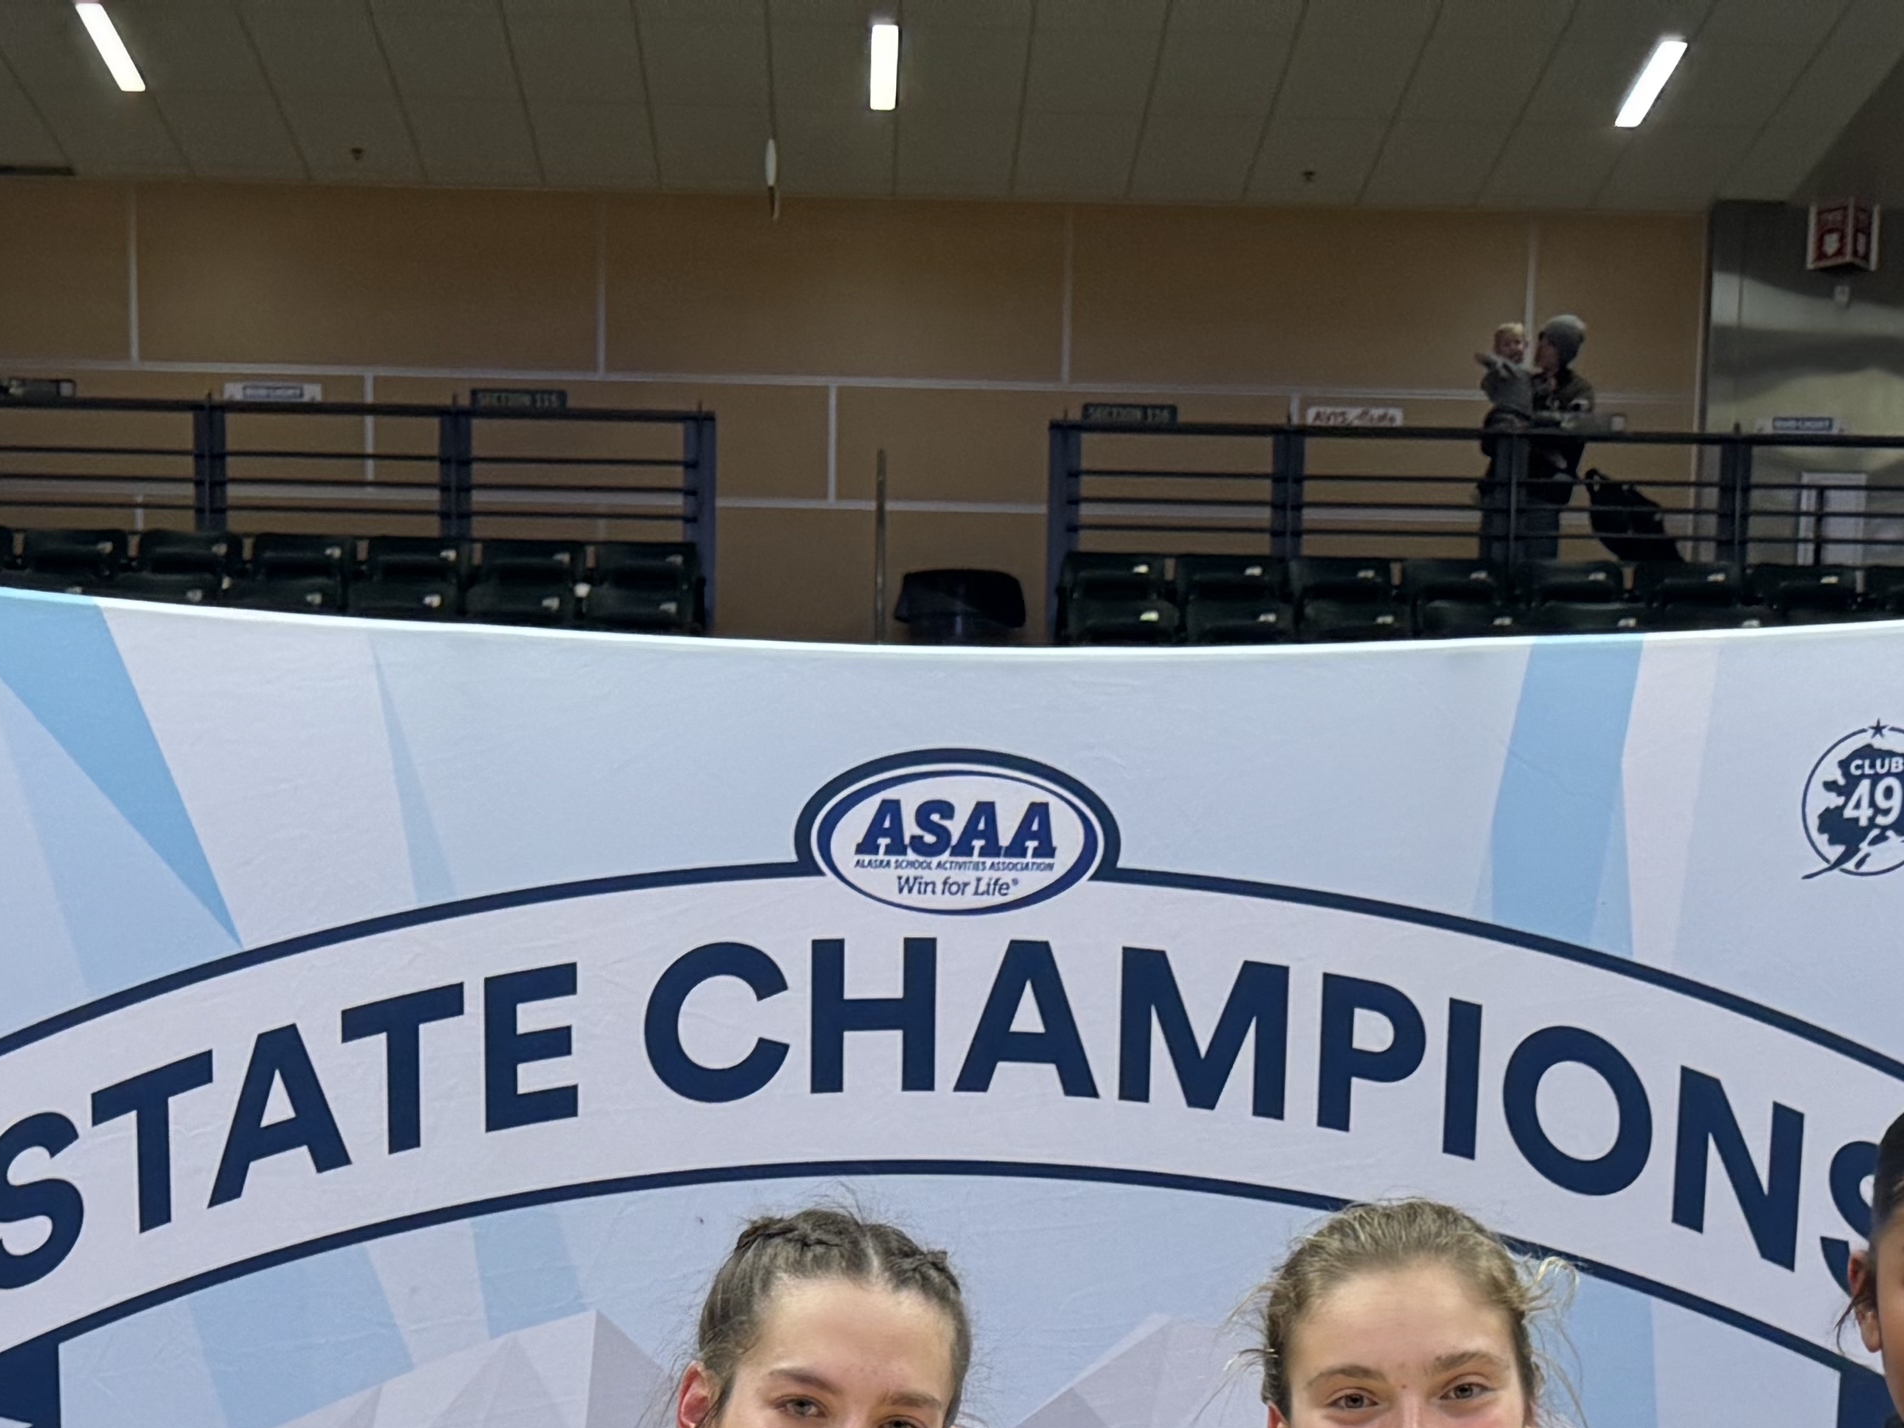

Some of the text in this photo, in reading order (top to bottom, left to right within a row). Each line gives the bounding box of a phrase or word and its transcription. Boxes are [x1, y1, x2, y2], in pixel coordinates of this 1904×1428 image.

[1849, 755, 1904, 777] CLUB
[1842, 778, 1904, 828] 49
[854, 798, 1058, 859] ASAA
[854, 858, 1056, 873] ALASKA SCHOOL ACTIVITIES ASSOCIATION
[896, 875, 936, 896] Win
[940, 876, 968, 896] for
